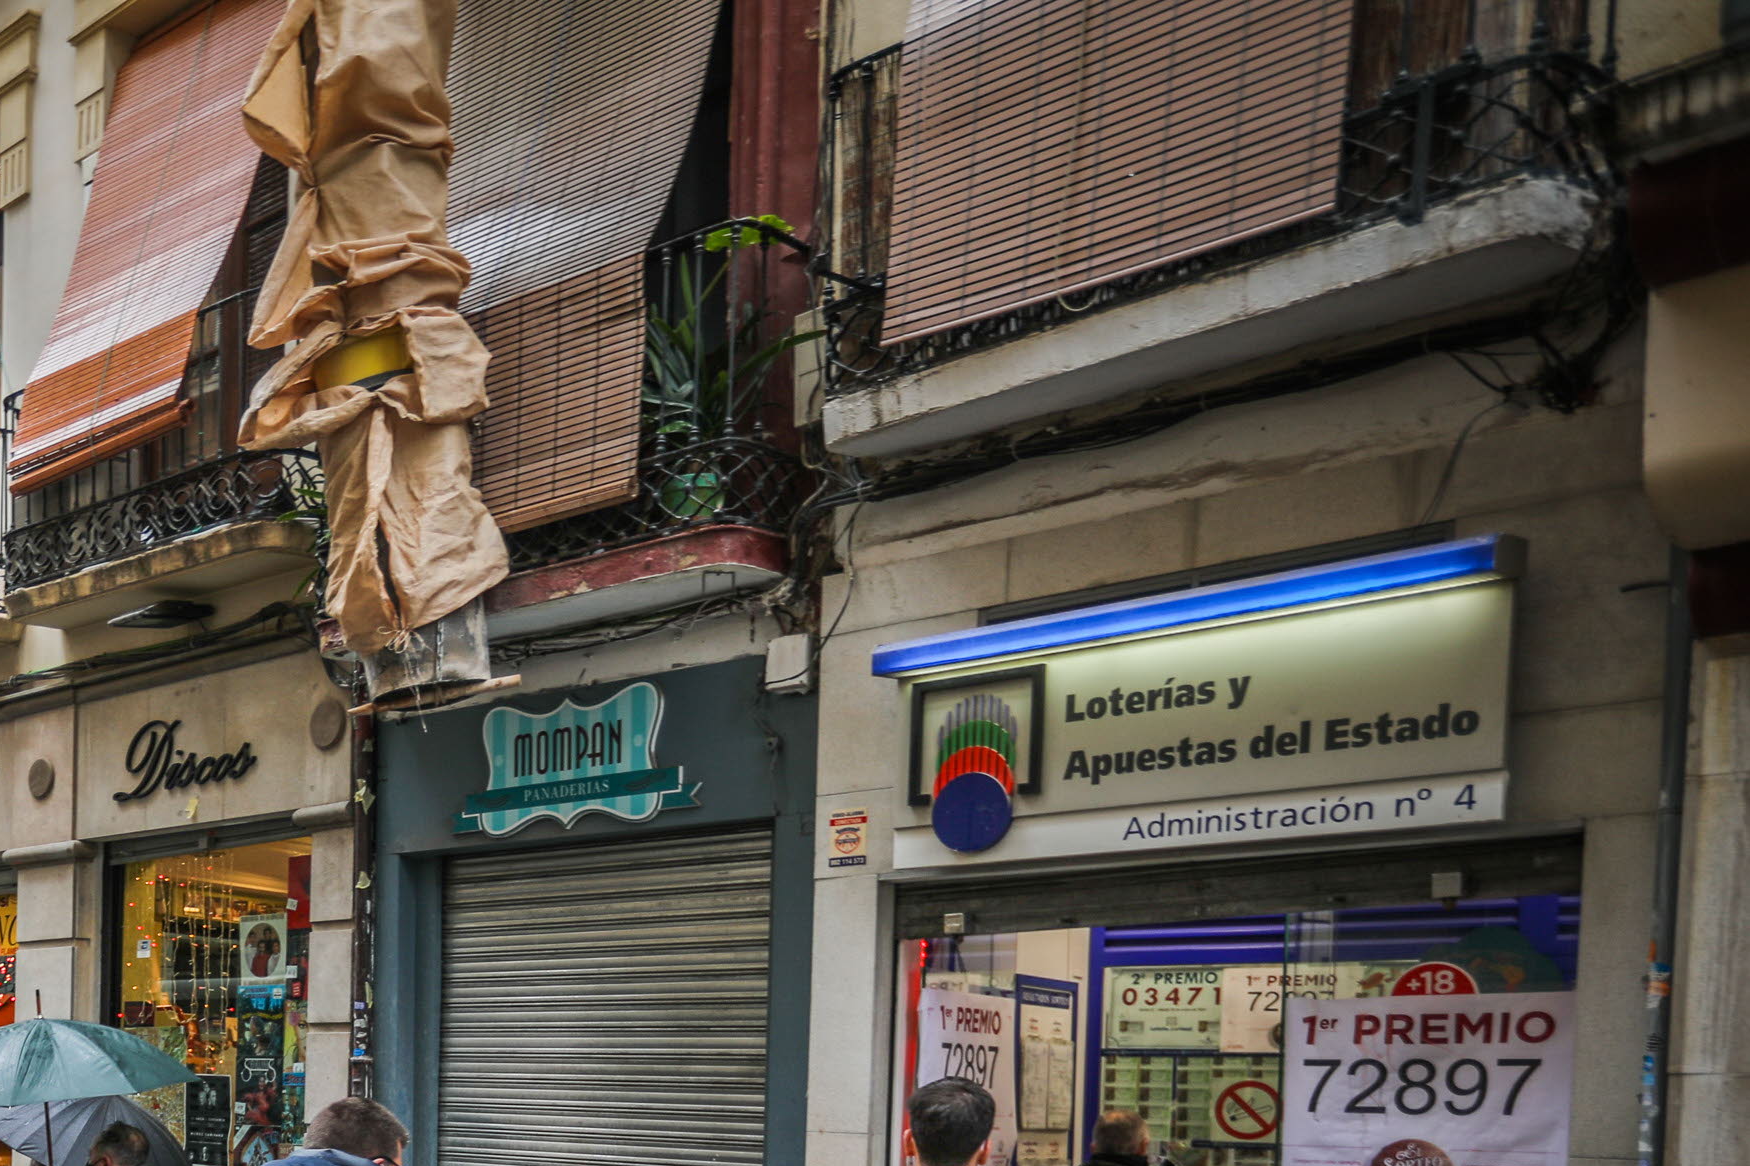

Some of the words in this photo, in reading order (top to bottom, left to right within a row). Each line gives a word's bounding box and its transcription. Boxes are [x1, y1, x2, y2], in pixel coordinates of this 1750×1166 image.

[1065, 677, 1217, 722] Loterías
[1227, 674, 1251, 709] y
[112, 719, 258, 802] Discos
[514, 719, 623, 778] MOMPAN
[1063, 733, 1237, 785] Apuestas
[1249, 720, 1311, 760] del
[1323, 703, 1480, 751] Estado
[523, 779, 610, 802] PANADERIAS
[1122, 795, 1374, 841] Administración
[1394, 787, 1433, 818] nº
[1453, 783, 1477, 811] 4
[1122, 986, 1222, 1006] 03471
[1154, 972, 1218, 984] PREMIO
[1266, 974, 1337, 987] PREMIO
[1407, 970, 1455, 994] +18
[956, 1007, 1002, 1035] PREMIO
[1303, 1015, 1338, 1046] 1er
[1353, 1010, 1557, 1046] PREMIO
[941, 1042, 999, 1089] 72897
[1303, 1057, 1543, 1116] 72897
